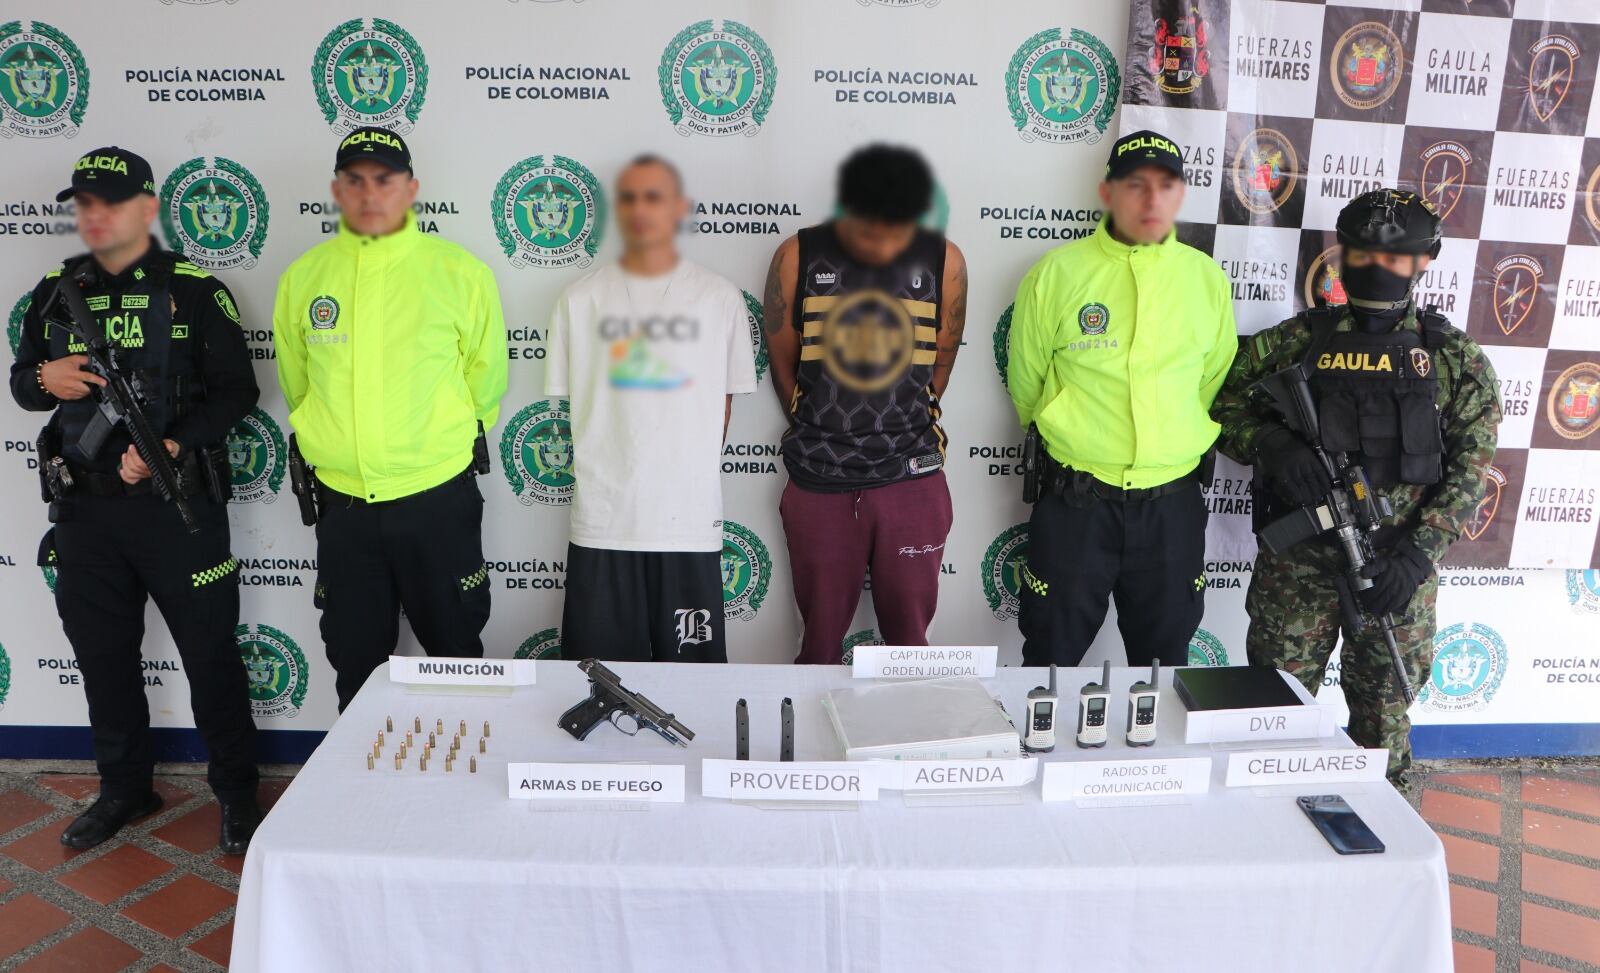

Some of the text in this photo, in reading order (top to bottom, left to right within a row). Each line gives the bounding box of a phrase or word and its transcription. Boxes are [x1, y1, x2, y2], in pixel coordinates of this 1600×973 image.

[1237, 35, 1312, 59] FUERZAS
[23, 34, 35, 42] DE
[45, 40, 76, 87] COLOMBIA
[327, 36, 355, 84] REPUBLICA
[385, 36, 414, 84] COLOMBIA
[673, 37, 704, 85] REPUBLICA
[735, 38, 762, 86] COLOMBIA
[1428, 48, 1491, 73] GAULA
[125, 66, 285, 83] POLICÍA NACIONAL
[465, 63, 631, 81] POLICÍA NACIONAL
[814, 67, 978, 86] POLICÍA NACIONAL
[1020, 45, 1051, 91] REPUBLICA
[1081, 47, 1107, 94] COLOMBIA
[1236, 58, 1310, 82] MILITARES
[488, 86, 610, 100] DE COLOMBIA
[1425, 72, 1488, 97] MILITAR
[148, 88, 266, 102] DE COLOMBIA
[835, 89, 957, 105] DE COLOMBIA
[0, 97, 74, 124] OLICIA NACIONAL
[332, 94, 410, 122] POLICIA NACIONAL
[678, 95, 758, 123] POLICIA NACIONAL
[1024, 102, 1102, 130] POLICIA NACIONAL
[9, 122, 29, 134] DIOS
[39, 122, 67, 135] PATRIA
[688, 120, 709, 132] DIOS
[718, 121, 748, 134] PATRIA
[1032, 126, 1053, 139] DIOS
[1060, 128, 1090, 141] PATRIA
[341, 131, 402, 151] POLICÍA
[1117, 136, 1179, 157] POLICÍA
[1323, 154, 1384, 177] GAULA
[1495, 167, 1570, 190] FUERZAS
[227, 174, 256, 220] COLOMBIA
[506, 172, 535, 219] REPUBLICA
[565, 173, 594, 219] COLOMBIA
[1493, 187, 1566, 211] MILITARES
[0, 201, 39, 216] ICÍA
[711, 202, 802, 216] NACIONAL
[980, 205, 1103, 222] POLICÍA NACIO
[1000, 226, 1023, 239] DE
[179, 230, 253, 257] POLICIA NACIONAL
[512, 228, 590, 256] POLICIA NACIONAL
[190, 254, 211, 266] DIOS
[218, 254, 246, 267] PATRIA
[521, 252, 542, 265] DIOS
[551, 253, 580, 266] PATRIA
[1231, 282, 1286, 301] ILITARES
[106, 312, 144, 340] ICÍA
[507, 326, 542, 341] ICÍA
[748, 315, 760, 346] OMBIA
[508, 347, 519, 359] E
[1316, 352, 1393, 372] GAULA
[246, 416, 275, 458] COLOMBIA
[514, 416, 541, 460] REPUBLICA
[721, 443, 784, 456] ACIONA
[27, 458, 38, 469] D
[721, 462, 778, 473] OMBIA
[988, 464, 1011, 476] DE
[238, 467, 272, 492] NACIONAL
[520, 468, 548, 493] POLICIA
[239, 490, 265, 502] PATRIA
[529, 491, 549, 502] DIOS
[1528, 487, 1596, 505] FUERZAS
[1524, 506, 1593, 523] MILITARES
[238, 558, 319, 571] NACIONAL
[485, 558, 549, 573] POLICÍA
[732, 536, 758, 577] COLOMBIA
[994, 536, 1025, 578] REPUBLICA
[238, 574, 303, 587] LOMBIA
[506, 578, 528, 589] DE
[1437, 575, 1525, 587] E COLOMBIA
[724, 586, 755, 609] ACIONAL
[1006, 606, 1020, 617] DIO
[269, 638, 297, 677] COLOMBIA
[890, 650, 973, 662] CAPTURA POR
[1479, 636, 1497, 673] COLOMBIA
[1532, 656, 1586, 669] POLICÍA
[38, 658, 80, 670] POLIC
[882, 664, 979, 677] ORDEN JUDICIAL
[58, 674, 80, 685] DE
[1546, 673, 1566, 684] DE
[262, 685, 294, 707] NACIONAL
[262, 705, 288, 716] PATRIA
[1249, 715, 1287, 732] DVR
[1102, 764, 1168, 778] RADIOS DE
[1247, 754, 1368, 774] CELULARES
[730, 771, 861, 792] PROVEEDOR
[915, 766, 1005, 784] AGENDA
[519, 778, 663, 792] ARMAS DE FUEGO
[1083, 778, 1184, 796] COMUNICACIÓN
